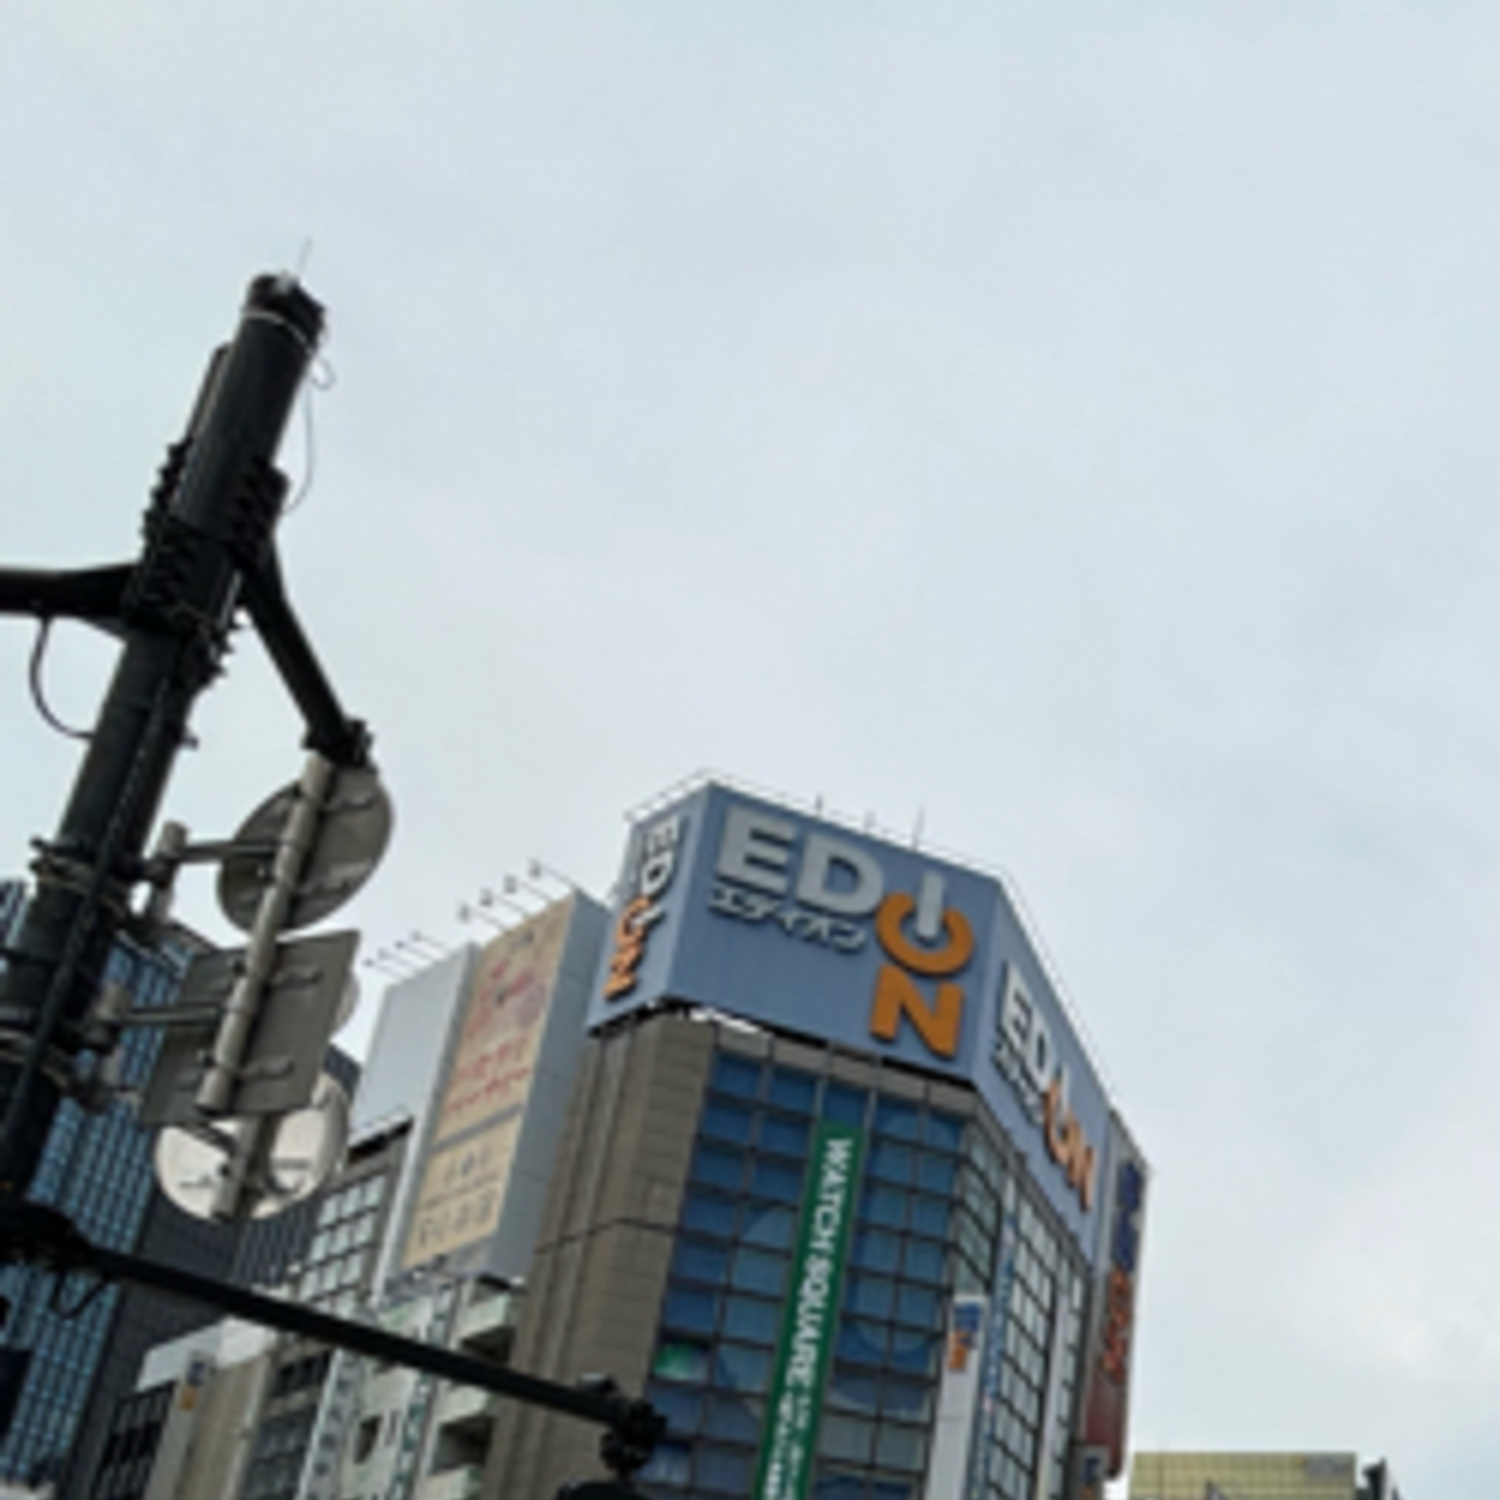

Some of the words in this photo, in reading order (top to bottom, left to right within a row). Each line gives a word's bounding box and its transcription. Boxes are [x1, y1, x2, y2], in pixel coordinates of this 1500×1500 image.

[718, 805, 976, 1058] EDION
[810, 1138, 852, 1252] WATCH
[787, 1256, 833, 1388] SQUARE
